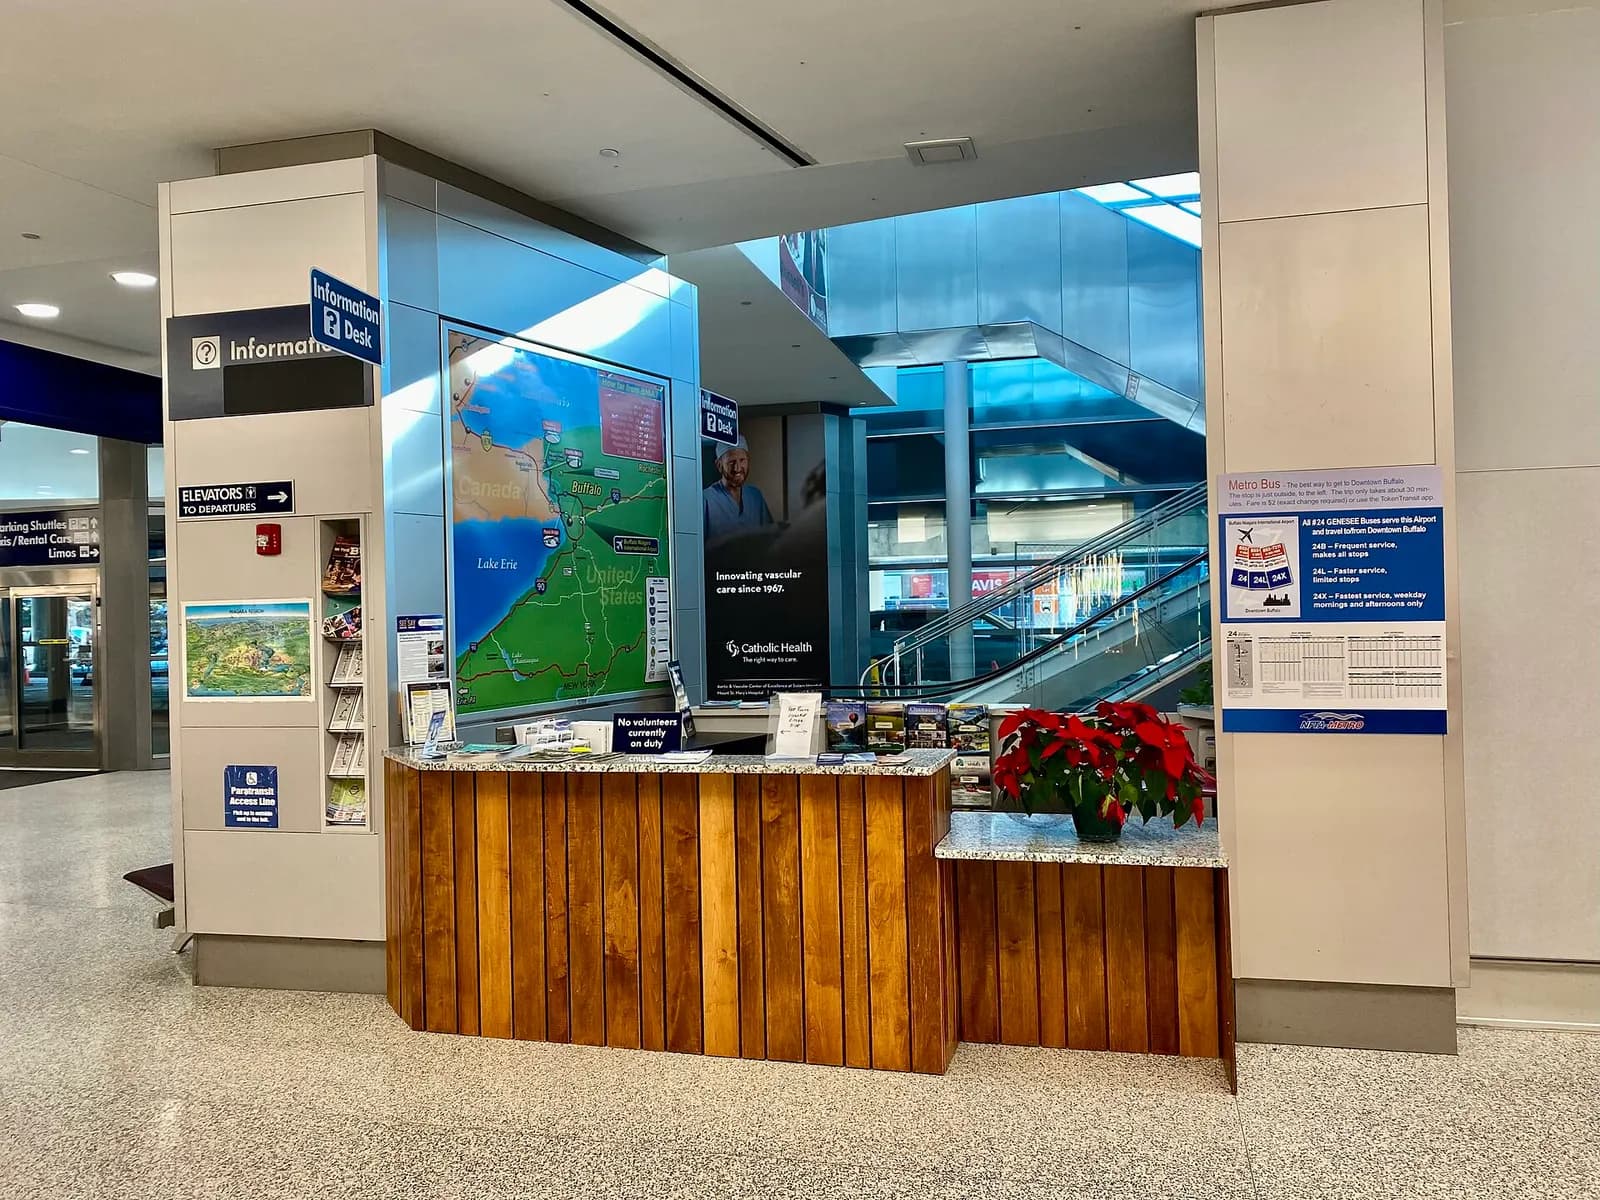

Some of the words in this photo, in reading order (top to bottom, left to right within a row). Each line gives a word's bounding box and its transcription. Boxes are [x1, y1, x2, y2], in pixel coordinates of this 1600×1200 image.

[313, 277, 379, 326] Information
[344, 319, 373, 349] Desk
[701, 395, 737, 420] Information
[717, 418, 733, 436] Desk
[459, 476, 521, 500] Canada
[571, 480, 602, 496] Buffalo
[1228, 480, 1258, 490] Metro
[1260, 479, 1281, 489] Bus
[1313, 481, 1325, 489] way
[1333, 480, 1343, 488] get
[1351, 479, 1383, 487] Downtown
[1383, 478, 1405, 486] Buffalo
[182, 487, 243, 503] ELEVATORS
[1242, 492, 1255, 500] stop
[1262, 491, 1273, 500] just
[1274, 490, 1297, 498] outside,
[1306, 489, 1316, 497] the
[1331, 488, 1343, 496] The
[1344, 488, 1354, 497] trip
[1355, 488, 1369, 496] only
[1369, 487, 1386, 495] takes
[1387, 486, 1405, 494] about
[1268, 499, 1276, 507] $2
[1277, 498, 1296, 507] (exact
[1296, 498, 1319, 507] change
[1320, 497, 1348, 506] required)
[183, 506, 197, 515] TO
[198, 503, 257, 513] DEPARTURES
[30, 519, 67, 531] Shuttles
[1312, 518, 1325, 526] #24
[1326, 517, 1360, 526] GENESEE
[1360, 517, 1381, 525] Buses
[1381, 516, 1400, 524] serve
[1400, 515, 1413, 523] this
[1413, 515, 1437, 524] Airport
[1325, 527, 1343, 535] travel
[1343, 526, 1367, 535] to/from
[1367, 526, 1402, 534] Downtown
[1402, 525, 1427, 533] Buffalo
[49, 533, 73, 544] Cars
[1312, 542, 1327, 550] 24B
[1334, 542, 1368, 551] Frequent
[1368, 541, 1398, 549] service,
[48, 547, 77, 558] Limos
[1347, 551, 1369, 559] stops
[477, 557, 499, 569] Lake
[500, 557, 518, 570] Erie
[586, 565, 634, 583] United
[716, 570, 763, 582] Innovating
[764, 568, 803, 579] vascular
[1312, 567, 1326, 575] 24L
[1333, 567, 1357, 575] Faster
[1358, 566, 1388, 575] service,
[1271, 572, 1288, 582] 24X
[1312, 576, 1338, 584] limited
[1339, 576, 1360, 584] stops
[536, 582, 545, 591] 90
[716, 586, 737, 594] care
[737, 584, 762, 593] since
[763, 583, 785, 593] 1967.
[971, 578, 1002, 592] AVIS
[599, 586, 643, 605] States
[1312, 592, 1328, 600] 24X
[1334, 592, 1362, 600] Fastest
[1363, 592, 1393, 600] service,
[1393, 591, 1427, 600] weekday
[1313, 601, 1348, 609] mornings
[1349, 600, 1364, 608] and
[1365, 600, 1405, 608] afternoons
[1406, 600, 1424, 609] only
[741, 642, 780, 653] Catholic
[781, 641, 813, 652] Health
[753, 656, 766, 664] right
[563, 682, 578, 690] NEW
[580, 681, 596, 689] YORK
[617, 717, 632, 727] No
[632, 717, 678, 727] volunteers
[1300, 720, 1365, 730] NFTA-METRO
[628, 729, 666, 739] currently
[630, 740, 642, 748] on
[643, 739, 663, 750] duty
[231, 786, 274, 796] Paratransit
[229, 797, 258, 806] Access
[258, 797, 276, 806] Line
